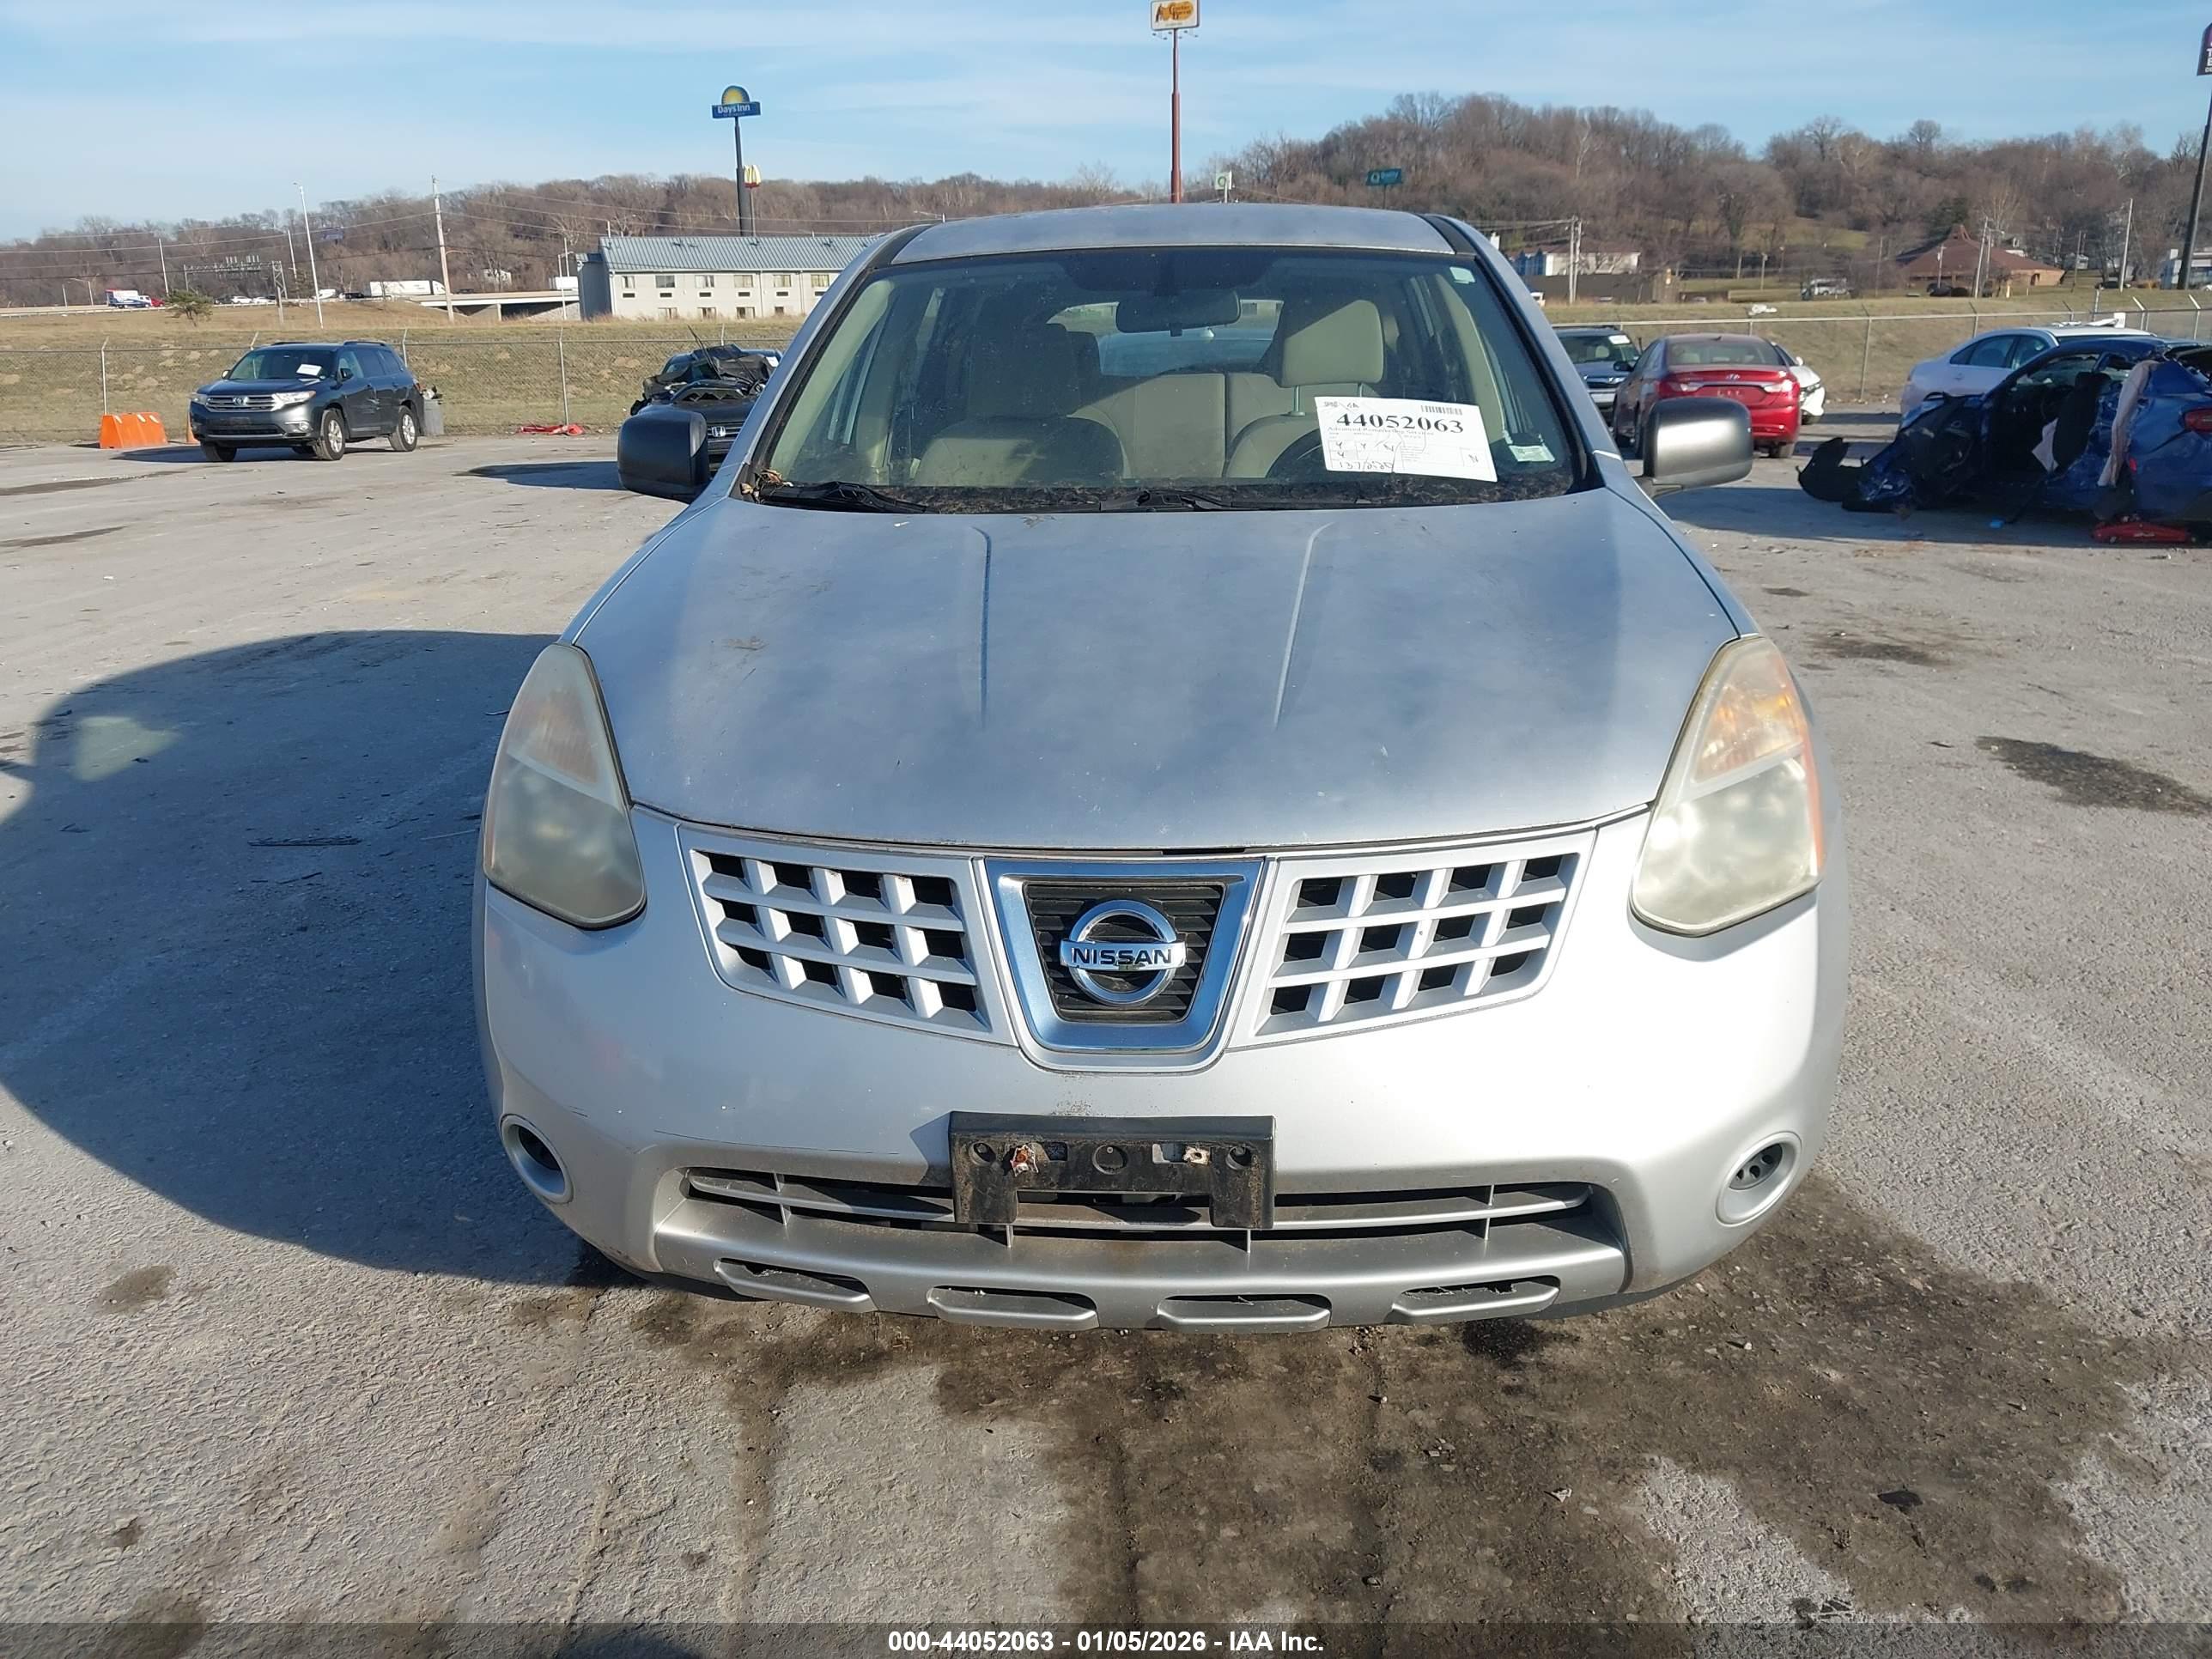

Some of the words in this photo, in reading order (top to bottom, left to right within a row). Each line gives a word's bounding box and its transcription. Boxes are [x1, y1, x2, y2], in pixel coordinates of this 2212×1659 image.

[717, 105, 737, 114] Days
[737, 103, 751, 112] Inn
[1336, 413, 1464, 434] 44052063
[1072, 947, 1172, 966] NISSAN
